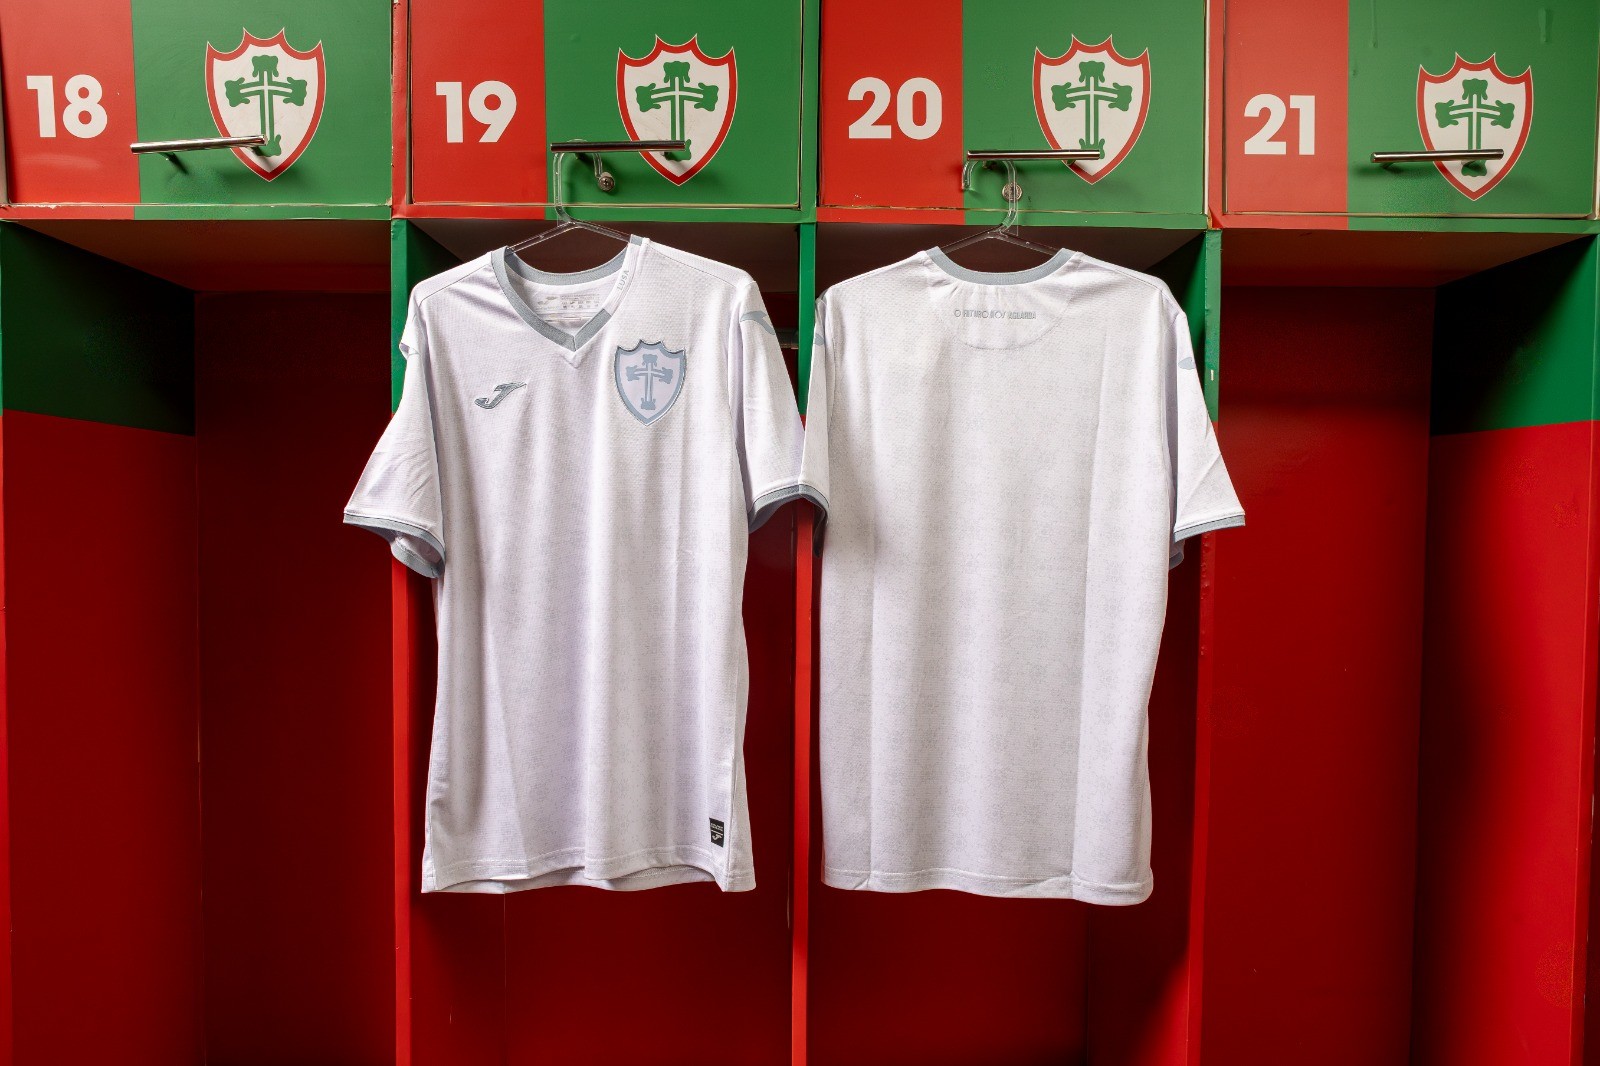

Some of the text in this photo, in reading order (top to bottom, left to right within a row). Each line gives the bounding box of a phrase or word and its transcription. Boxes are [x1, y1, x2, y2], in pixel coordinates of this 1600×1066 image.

[26, 74, 107, 138] 18
[436, 81, 517, 143] 19
[848, 77, 942, 140] 20
[1244, 94, 1315, 155] 21
[616, 270, 629, 291] LUSA
[954, 309, 962, 317] O
